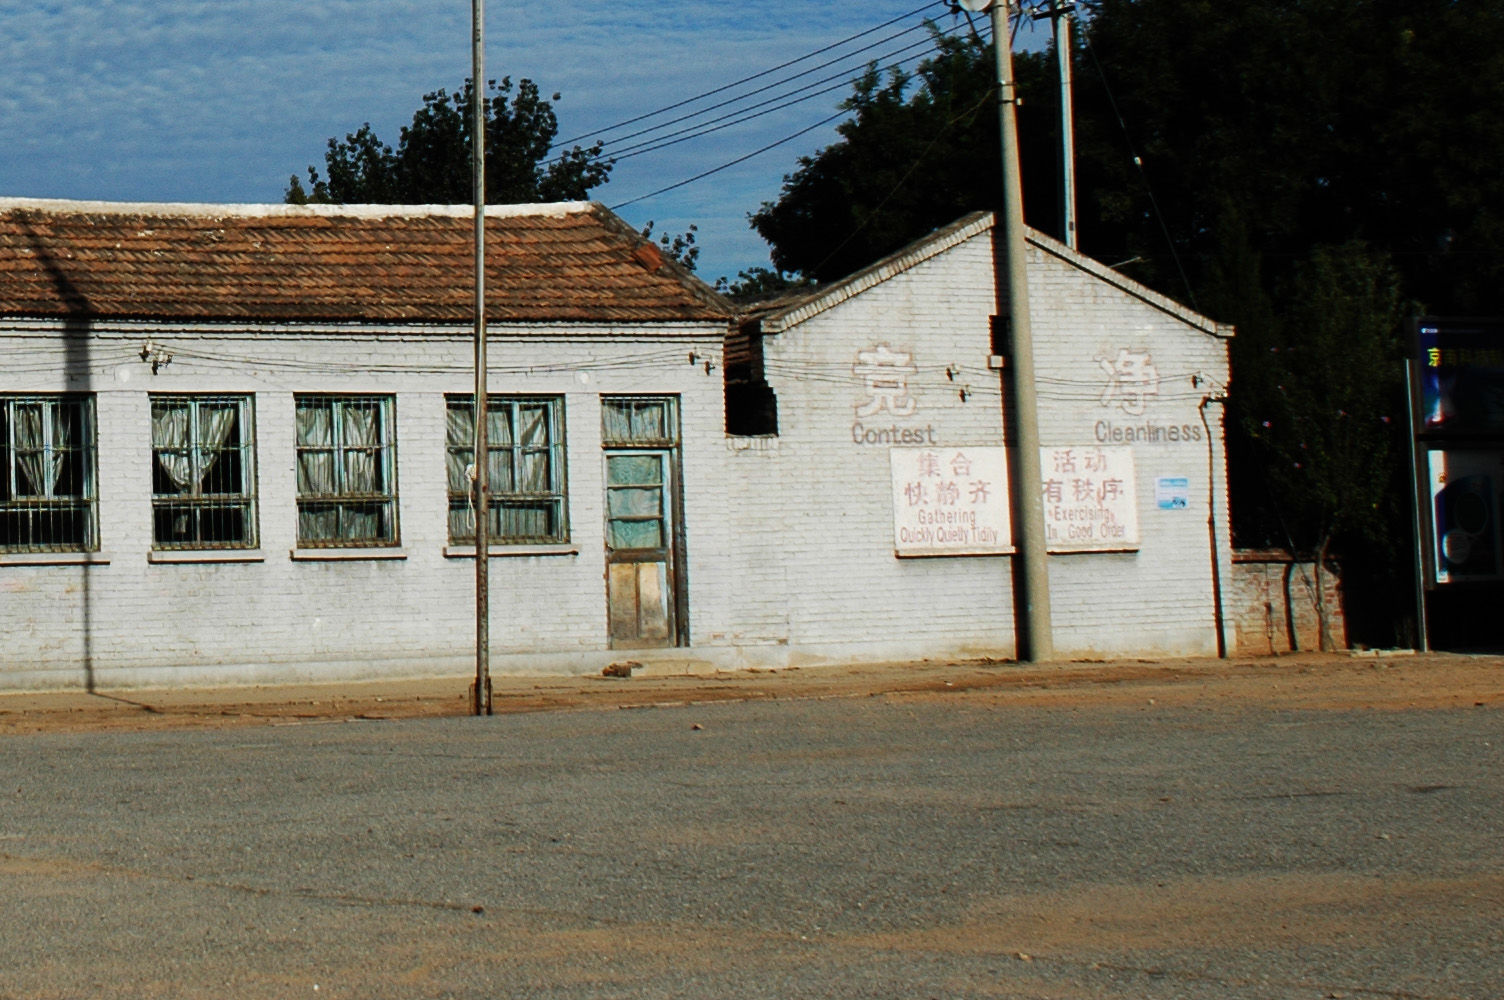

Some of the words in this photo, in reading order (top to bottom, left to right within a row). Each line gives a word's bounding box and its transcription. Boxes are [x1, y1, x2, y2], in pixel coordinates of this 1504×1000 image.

[851, 341, 918, 418] 竞
[1092, 346, 1160, 416] 净
[851, 421, 937, 445] Contest
[1094, 420, 1202, 443] Cleanliness
[916, 450, 973, 477] 集合
[1052, 448, 1108, 473] 活动
[904, 479, 992, 507] 快静齐
[1041, 477, 1124, 503] 有秩序
[918, 508, 976, 528] Gathering
[1067, 523, 1094, 539] Good
[1099, 522, 1126, 538] Order
[900, 526, 934, 545] Quickly
[936, 526, 969, 544] Quietly
